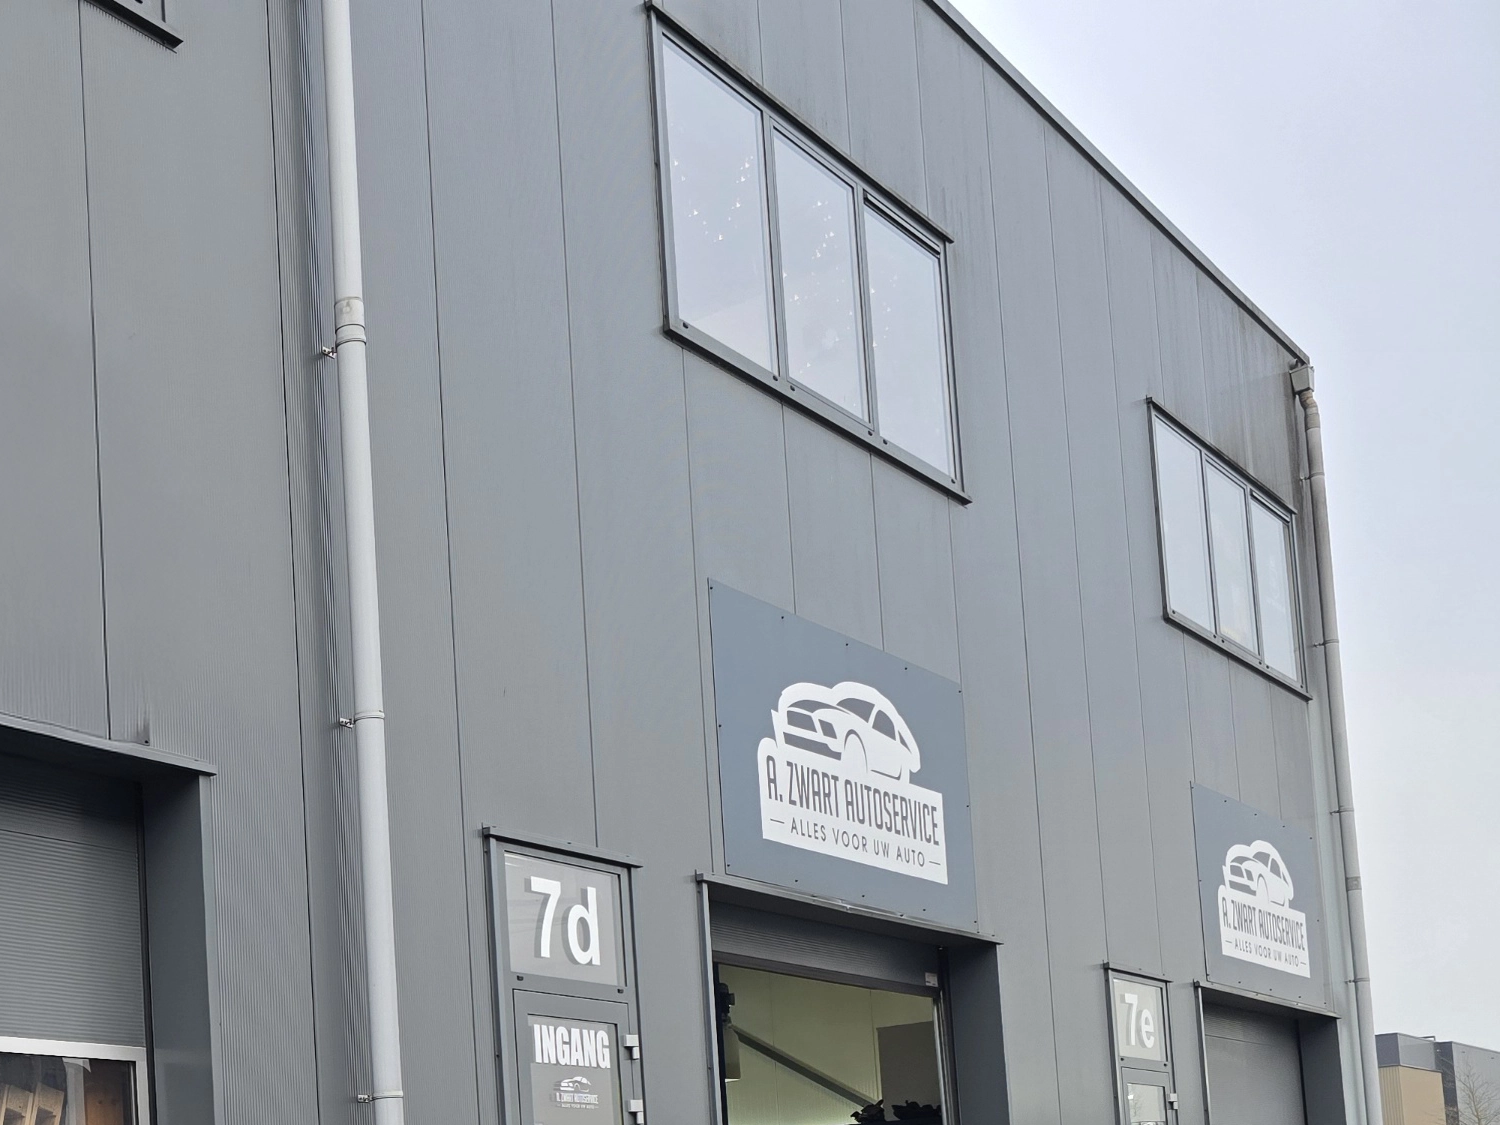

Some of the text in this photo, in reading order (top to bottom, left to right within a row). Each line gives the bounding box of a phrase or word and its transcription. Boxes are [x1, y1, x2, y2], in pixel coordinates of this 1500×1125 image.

[766, 754, 940, 846] A. ZWART AUTOSERVICE
[790, 817, 926, 867] ALLES VOOR UW AUTO
[530, 876, 602, 967] 7d
[1231, 899, 1257, 936] ZWART
[1259, 909, 1305, 951] AUTOSERVICE
[1235, 938, 1252, 954] ALLES
[1254, 944, 1272, 959] VOOR
[1284, 952, 1299, 967] AUTO
[533, 1023, 611, 1069] INGANG
[1124, 993, 1155, 1050] 7e
